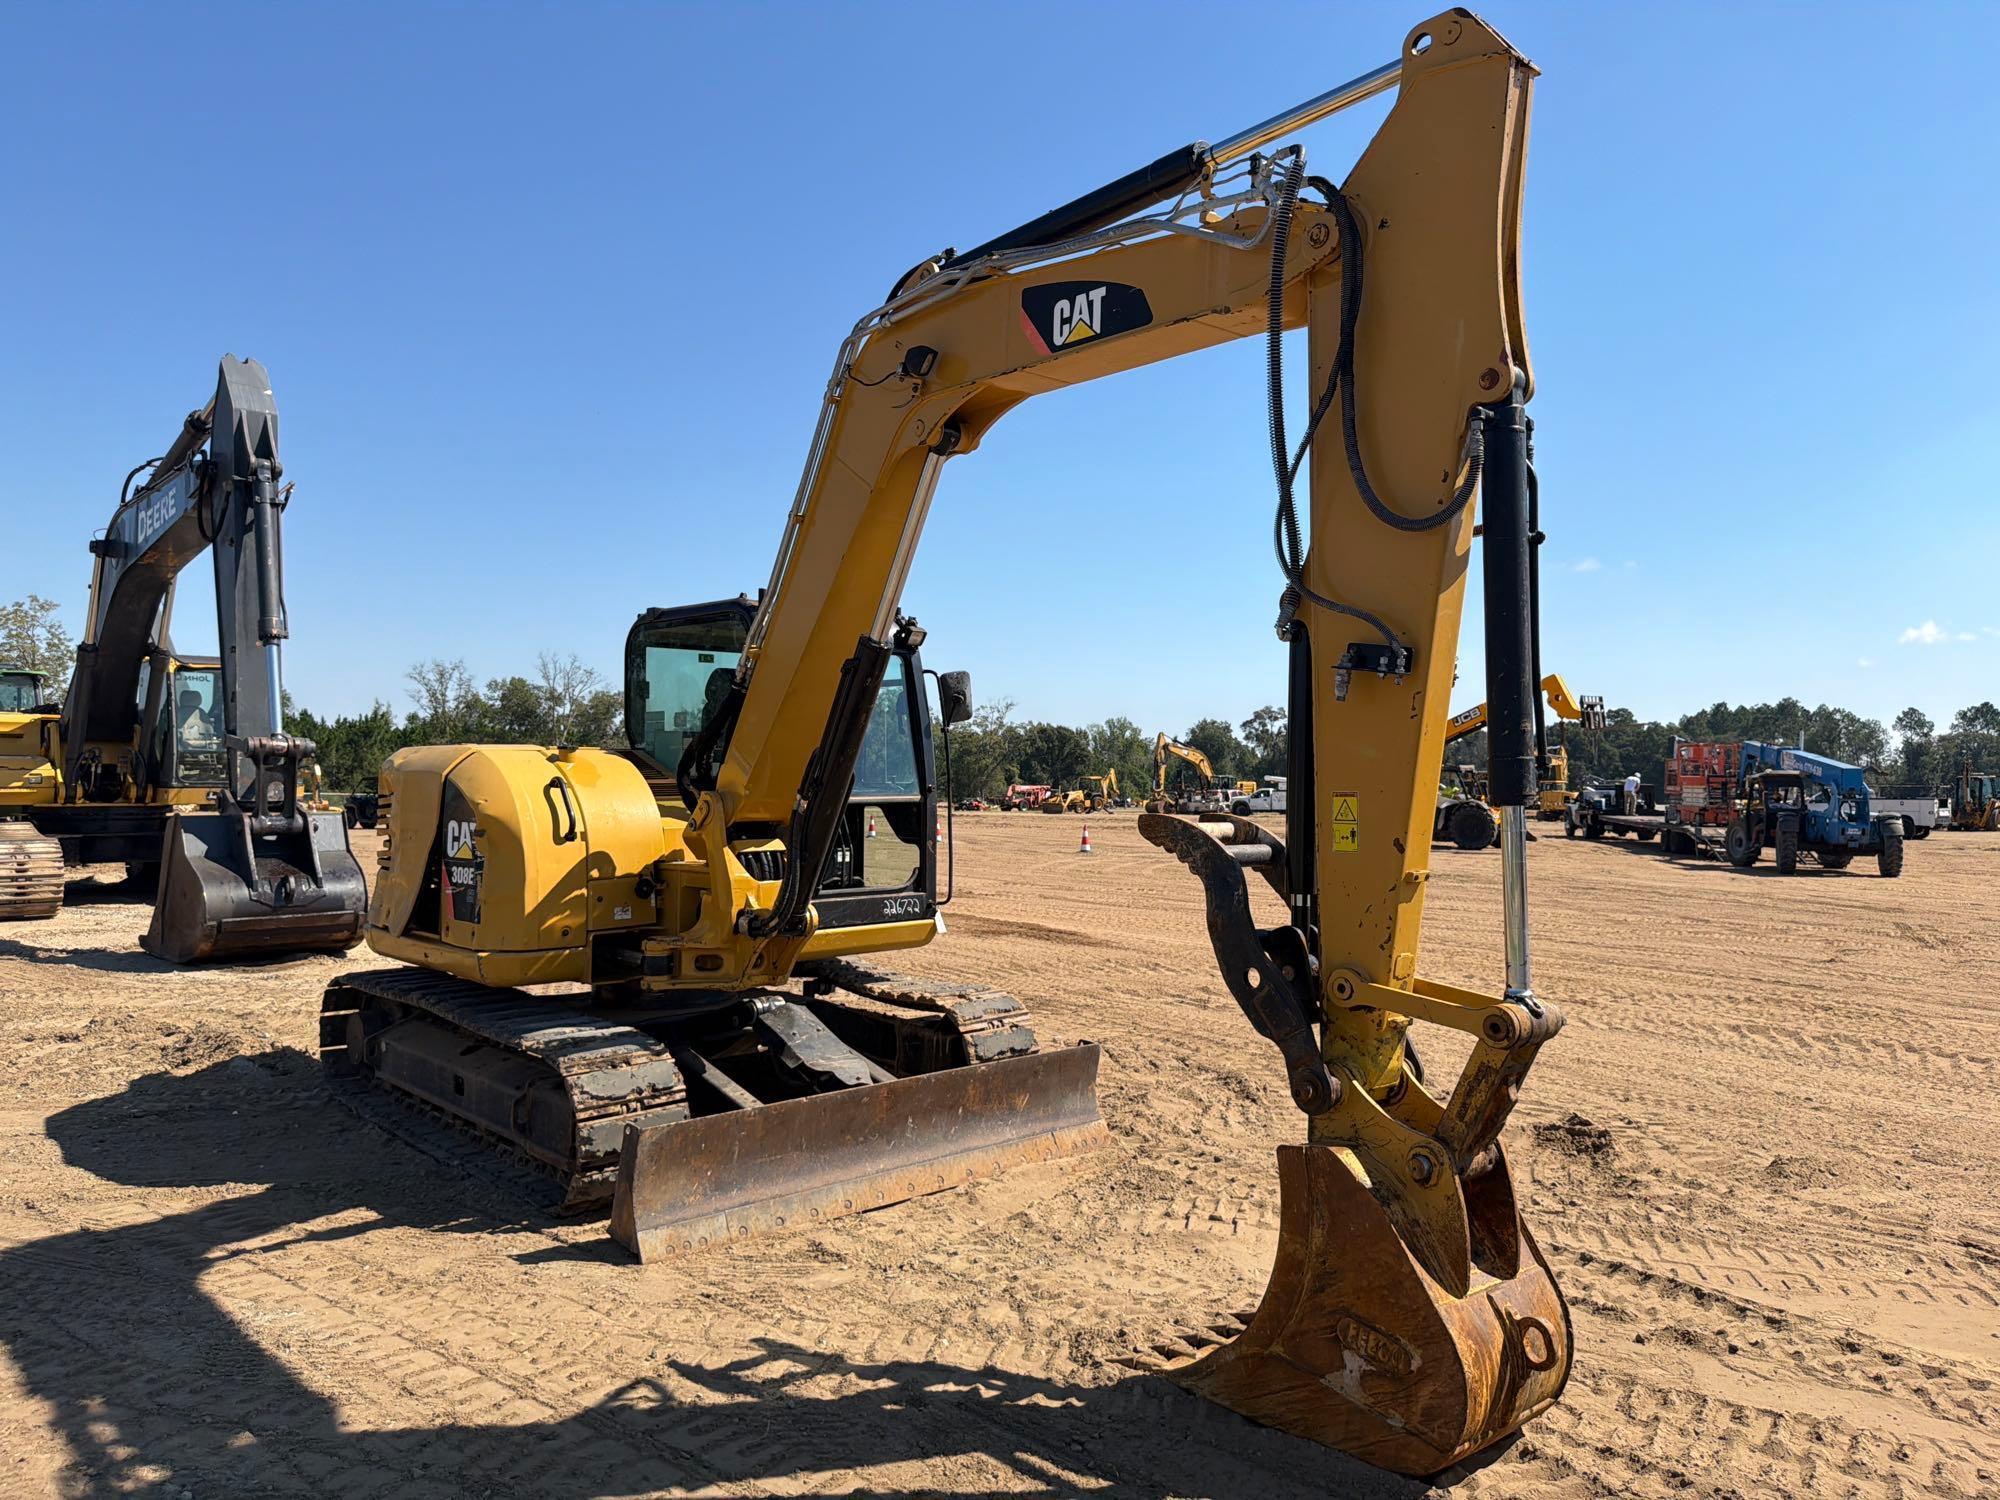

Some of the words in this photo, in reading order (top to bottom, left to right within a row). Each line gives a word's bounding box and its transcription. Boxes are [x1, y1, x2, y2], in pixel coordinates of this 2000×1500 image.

[1053, 286, 1107, 346] CAT
[138, 487, 177, 544] DEERE
[1454, 708, 1480, 726] JCB
[451, 866, 475, 885] 308E
[884, 898, 920, 917] 226722
